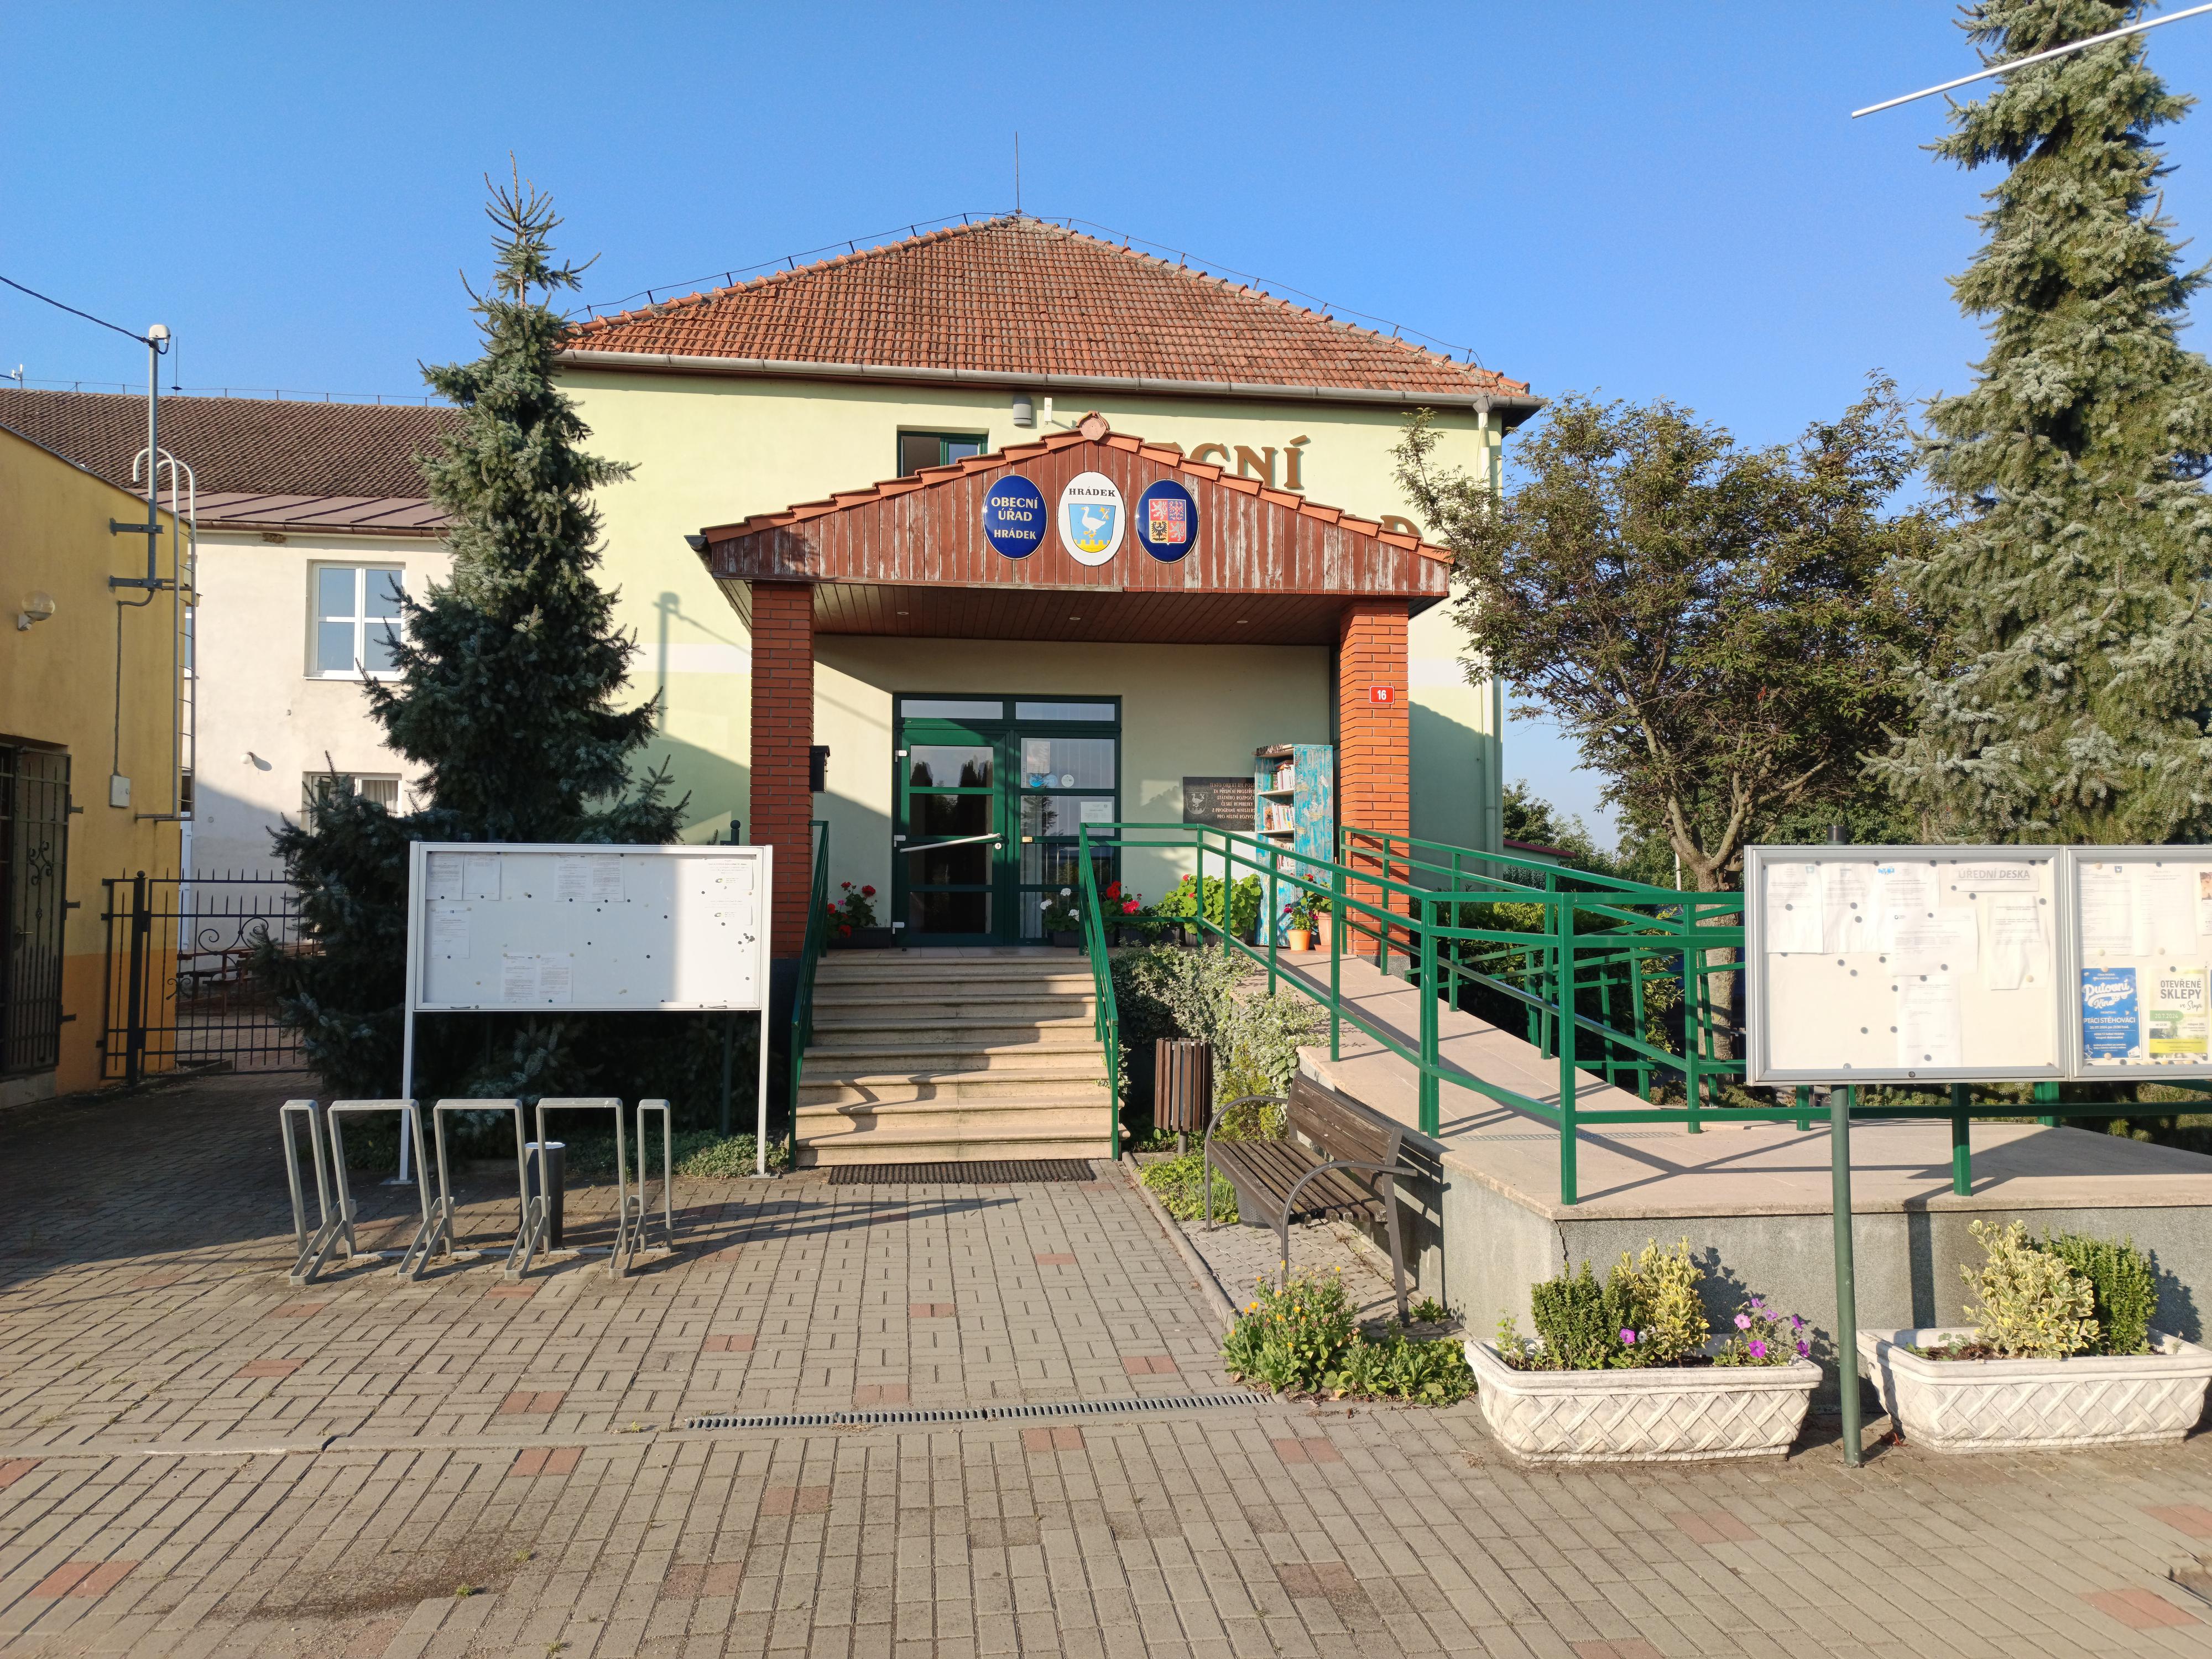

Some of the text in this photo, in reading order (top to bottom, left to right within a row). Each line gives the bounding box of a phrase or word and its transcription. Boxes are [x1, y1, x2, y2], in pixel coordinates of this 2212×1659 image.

[1068, 487, 1116, 497] HRÁDEK
[991, 497, 1038, 509] OBECNÍ
[998, 508, 1032, 521] ÚŘAD
[994, 528, 1037, 540] HRÁDEK
[1377, 690, 1387, 700] 16
[1958, 868, 2030, 878] ÚŘEDNÍ DESKA
[2161, 978, 2201, 988] OTEVŘENÉ
[2160, 989, 2201, 999] SKLEPY
